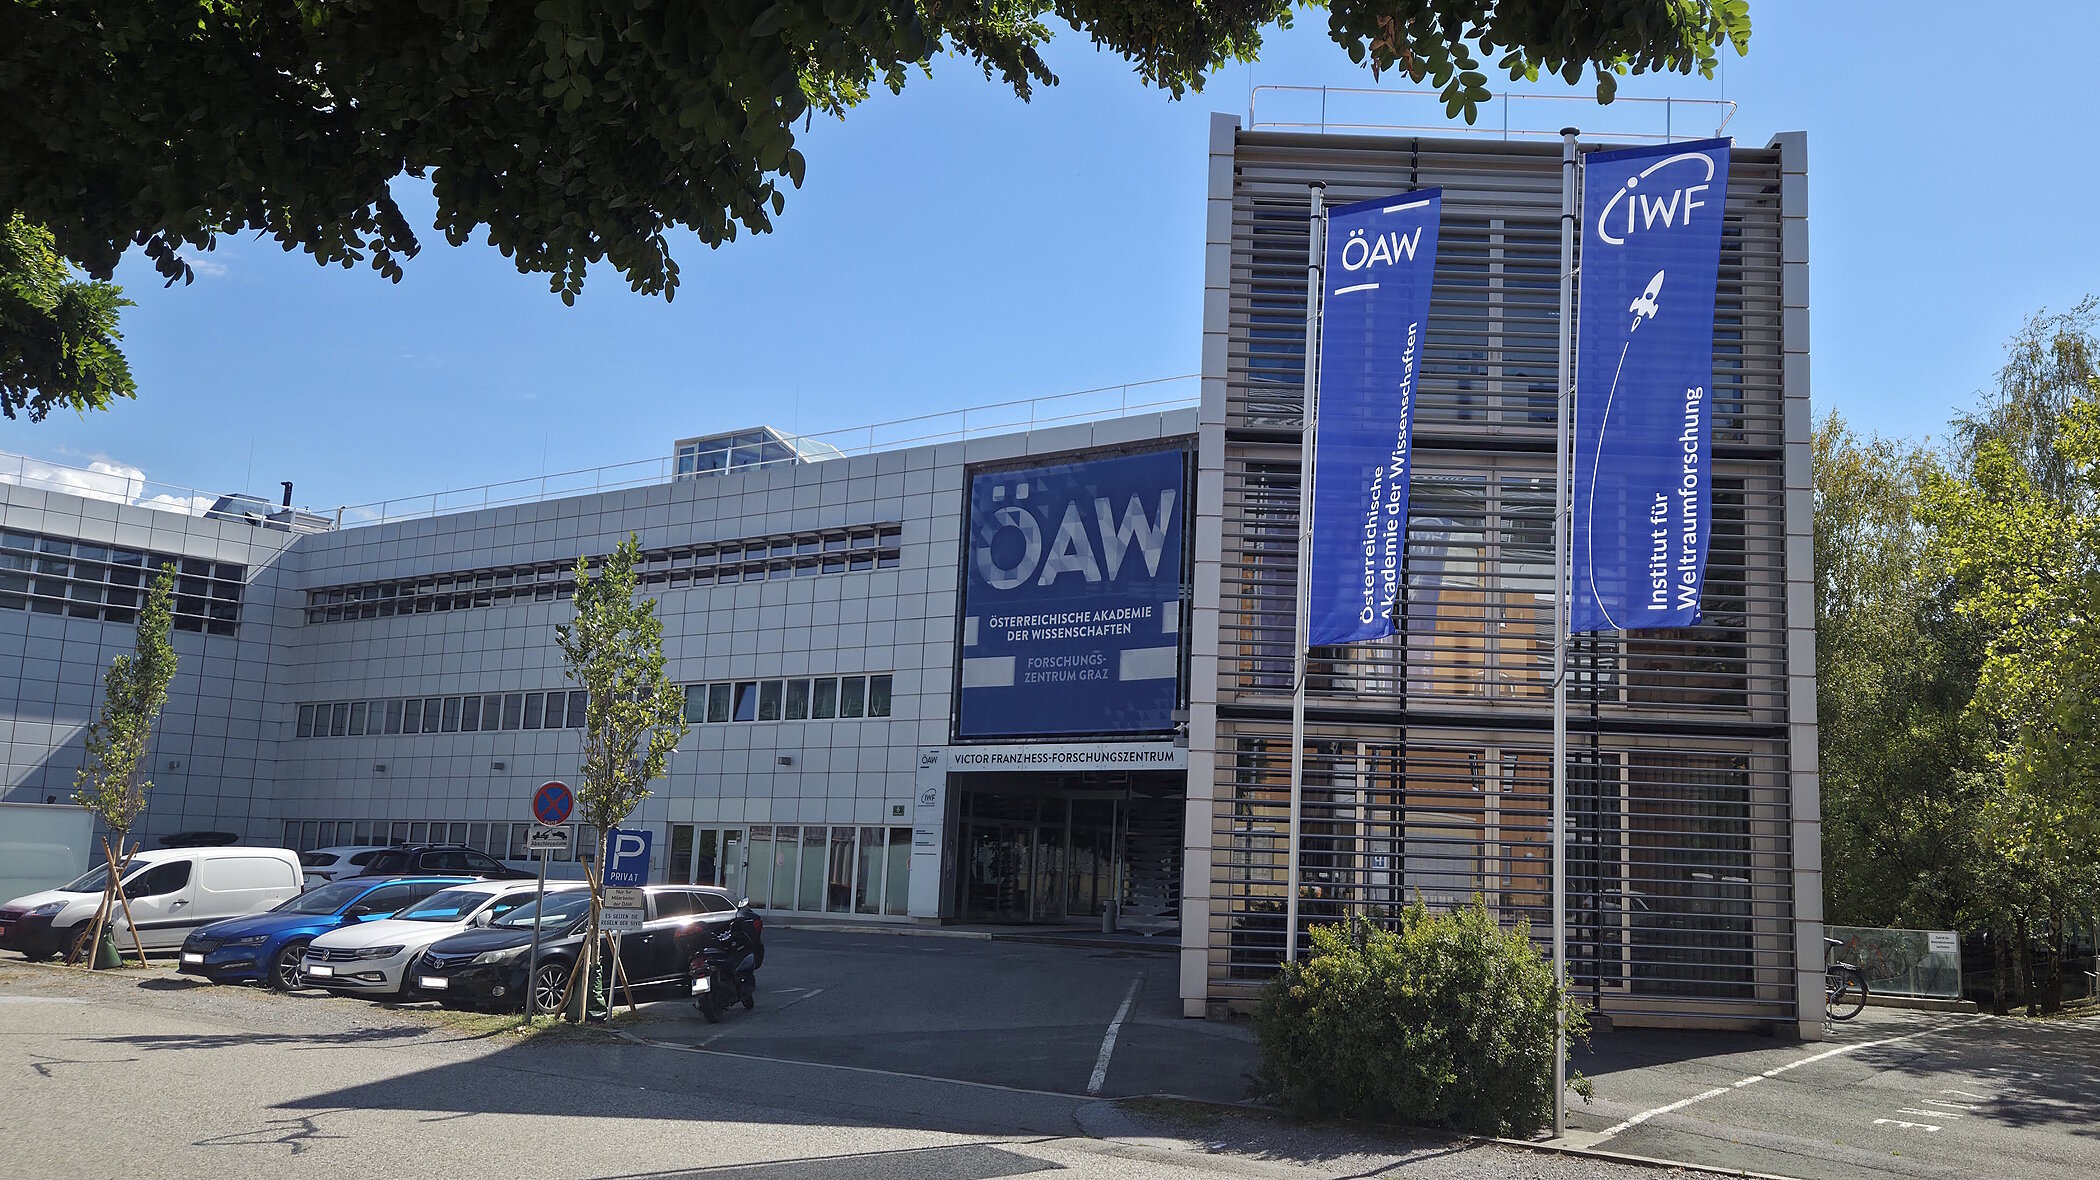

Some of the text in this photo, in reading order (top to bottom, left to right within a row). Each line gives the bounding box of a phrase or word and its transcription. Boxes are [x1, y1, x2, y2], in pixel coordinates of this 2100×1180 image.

[1342, 227, 1422, 271] ÖAW
[1381, 321, 1418, 619] Akademie der Wissenschaften
[1677, 386, 1704, 611] Weltraumforschung
[976, 483, 1176, 590] ÖAW
[1360, 466, 1384, 624] Österreichische
[1647, 492, 1668, 610] Institut für
[989, 606, 1152, 628] ÖSTERREICHISCHE AKADEMIE
[1007, 623, 1132, 642] DER WISSENSCHAFTEN
[1025, 668, 1109, 683] ZENTRUM GRAZ
[1028, 654, 1107, 669] FORSCHUNGS-
[922, 754, 938, 764] ÖAW
[954, 754, 989, 764] VICTOR
[612, 834, 645, 870] P
[610, 872, 639, 882] PRIVAT
